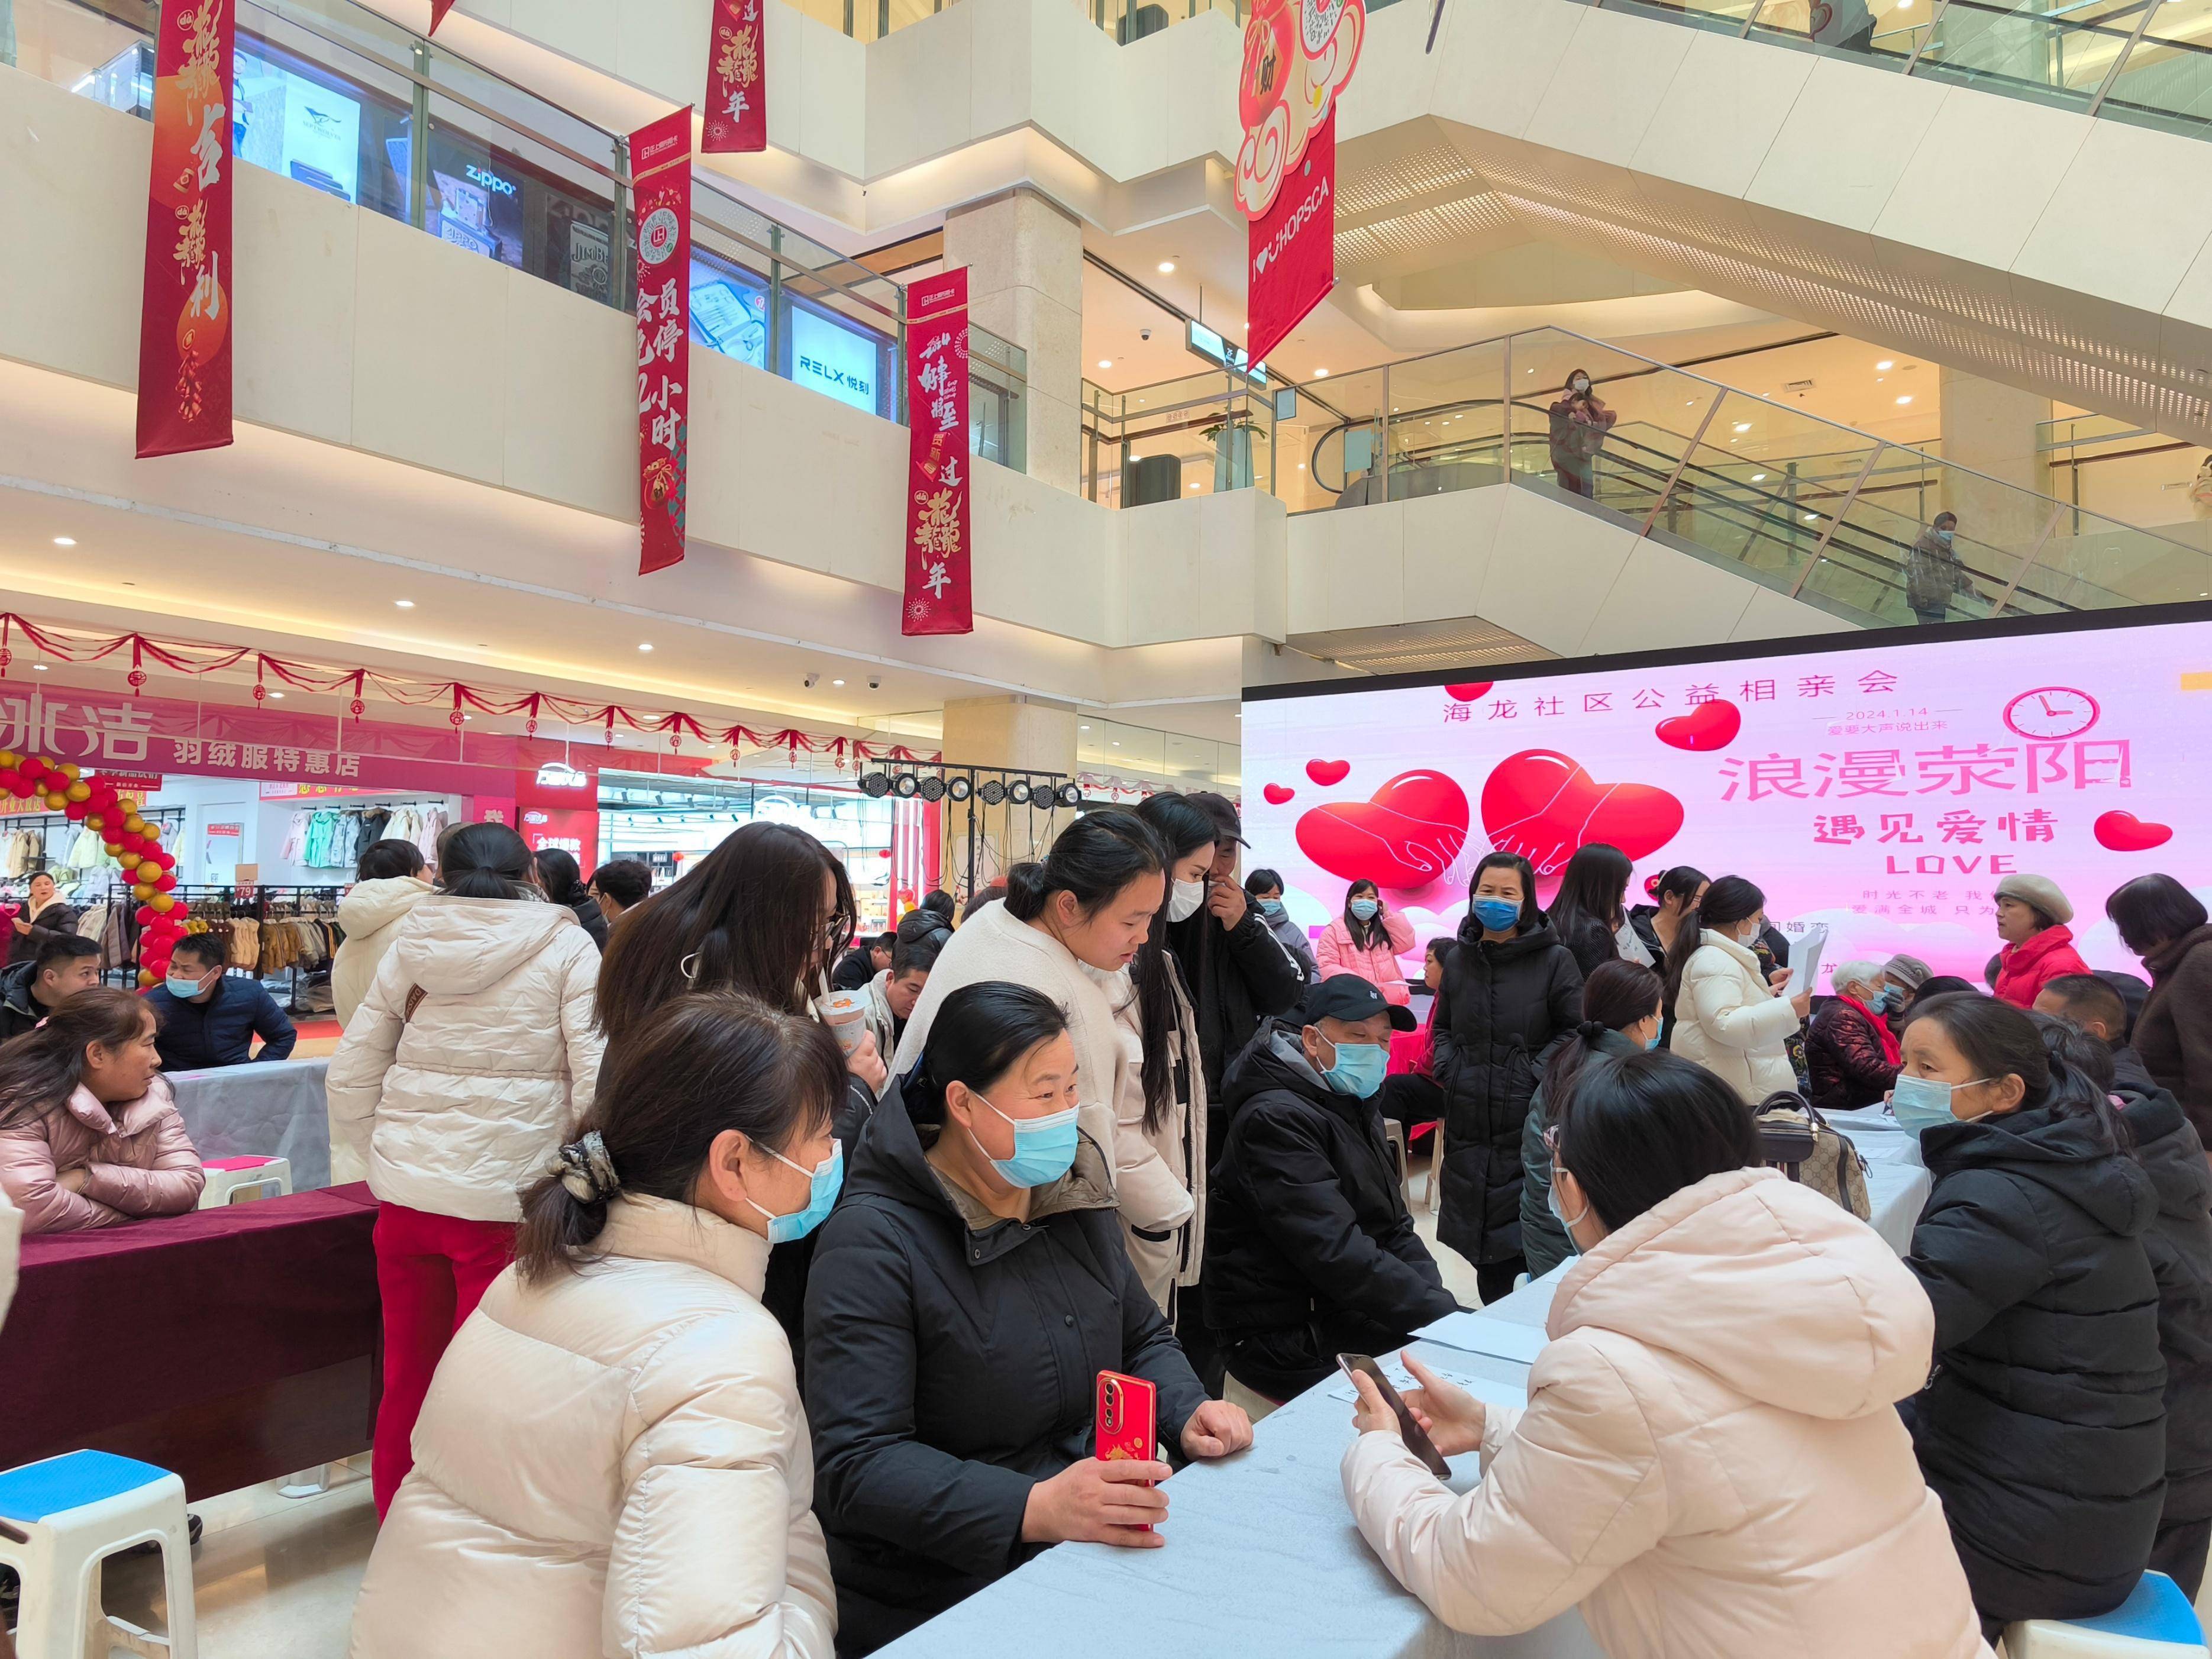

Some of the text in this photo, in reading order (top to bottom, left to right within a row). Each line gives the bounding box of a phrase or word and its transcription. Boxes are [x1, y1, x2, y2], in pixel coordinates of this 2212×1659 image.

[800, 356, 869, 395] RELX 悦刻
[1444, 670, 1897, 723] 海龙社区公益相亲会
[1827, 720, 1949, 735] 爱要大声说出来
[1846, 708, 1929, 720] 2024.1.14
[173, 739, 360, 777] 羽绒服特惠店
[1718, 738, 2132, 802] 浪漫荥阳
[1814, 808, 2059, 845] 遇见爱情
[1887, 855, 2017, 875] LOVE
[1863, 889, 1995, 900] 时光不老 我
[1852, 904, 1937, 915] 爱满全城
